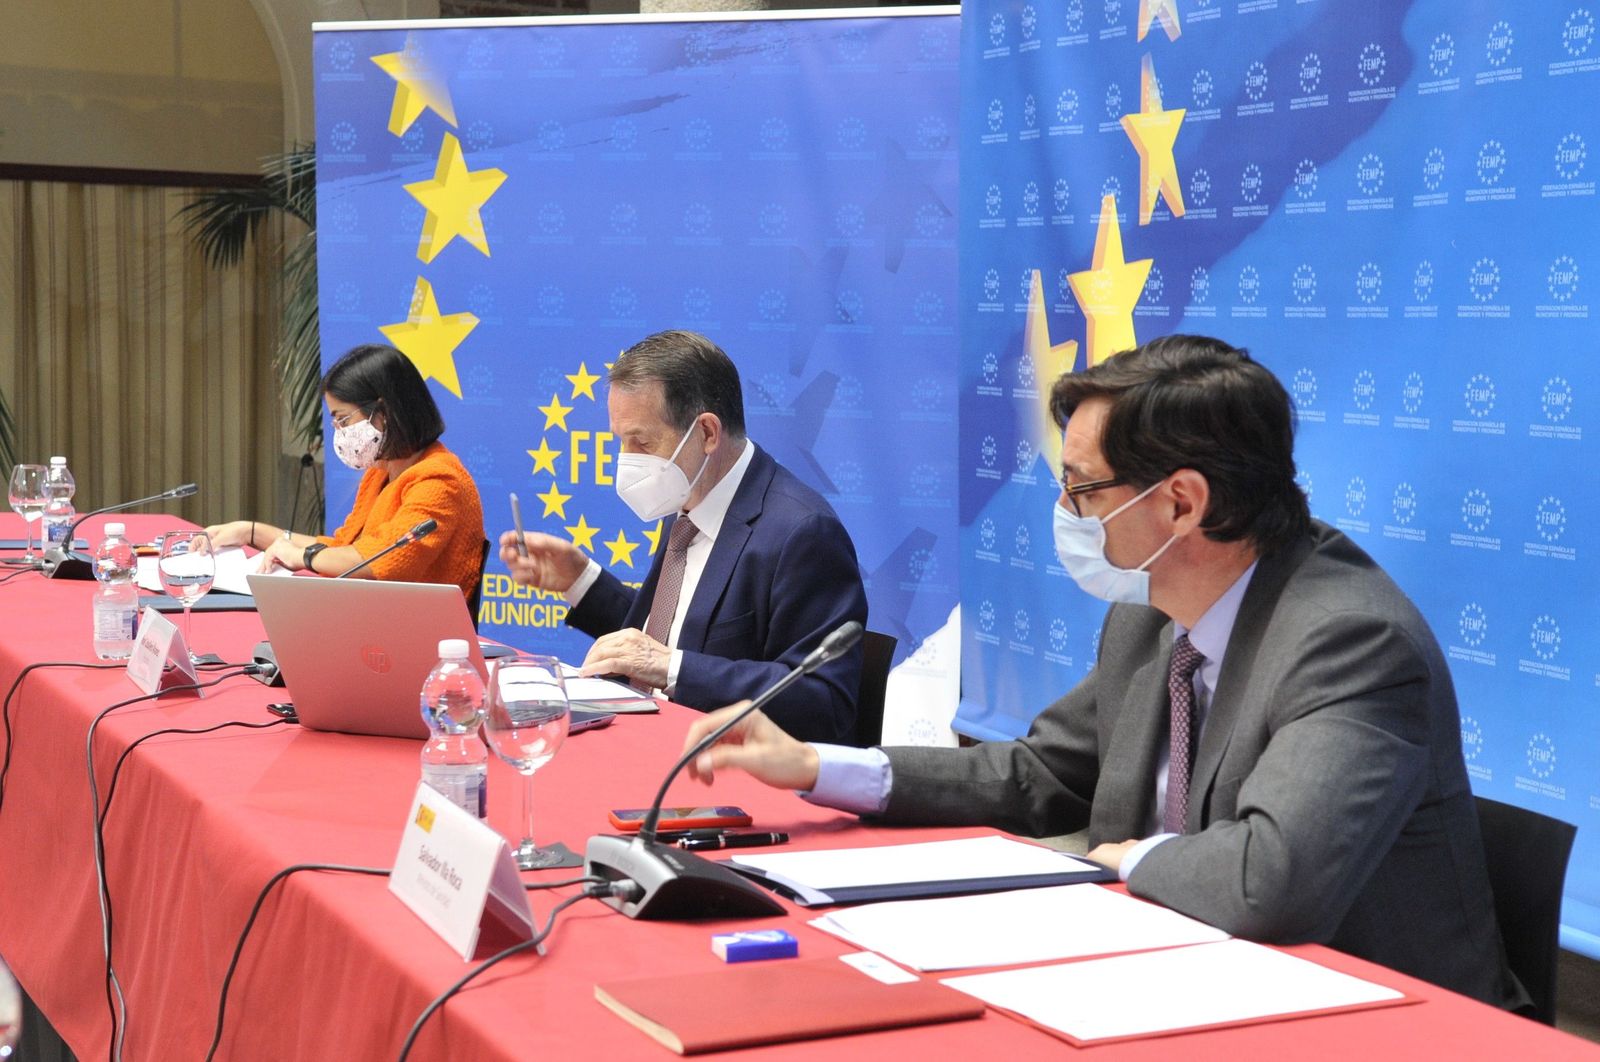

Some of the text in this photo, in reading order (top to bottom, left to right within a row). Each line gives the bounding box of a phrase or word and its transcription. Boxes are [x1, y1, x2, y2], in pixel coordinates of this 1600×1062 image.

[1569, 25, 1589, 39] FEMP
[1492, 37, 1509, 50] FEMP
[1434, 48, 1450, 60] FEMP
[1363, 58, 1381, 70] FEMP
[1304, 67, 1317, 79] FEMP
[1250, 75, 1264, 86] FEMP
[1196, 83, 1209, 93] FEMP
[1061, 101, 1074, 110] FEMP
[1482, 155, 1501, 168] FEMP
[1561, 149, 1581, 162] FEMP
[1362, 168, 1379, 180] FEMP
[1427, 163, 1440, 175] FEMP
[1245, 178, 1258, 189] FEMP
[1298, 173, 1313, 184] FEMP
[1194, 182, 1207, 192] FEMP
[1297, 278, 1312, 289] FEMP
[1361, 277, 1377, 288] FEMP
[1475, 273, 1494, 285] FEMP
[1554, 271, 1573, 284] FEMP
[1243, 279, 1256, 290] FEMP
[1297, 382, 1313, 394] FEMP
[1357, 384, 1371, 396] FEMP
[1407, 386, 1419, 398] FEMP
[1470, 389, 1490, 401] FEMP
[1547, 392, 1567, 405] FEMP
[1350, 490, 1362, 502] FEMP
[1398, 497, 1412, 509] FEMP
[1467, 504, 1486, 516] FEMP
[1542, 512, 1561, 525] FEMP
[478, 601, 568, 628] MUNICIP
[1464, 618, 1482, 630] FEMP
[1536, 631, 1556, 643] FEMP
[1532, 749, 1550, 762] FEMP
